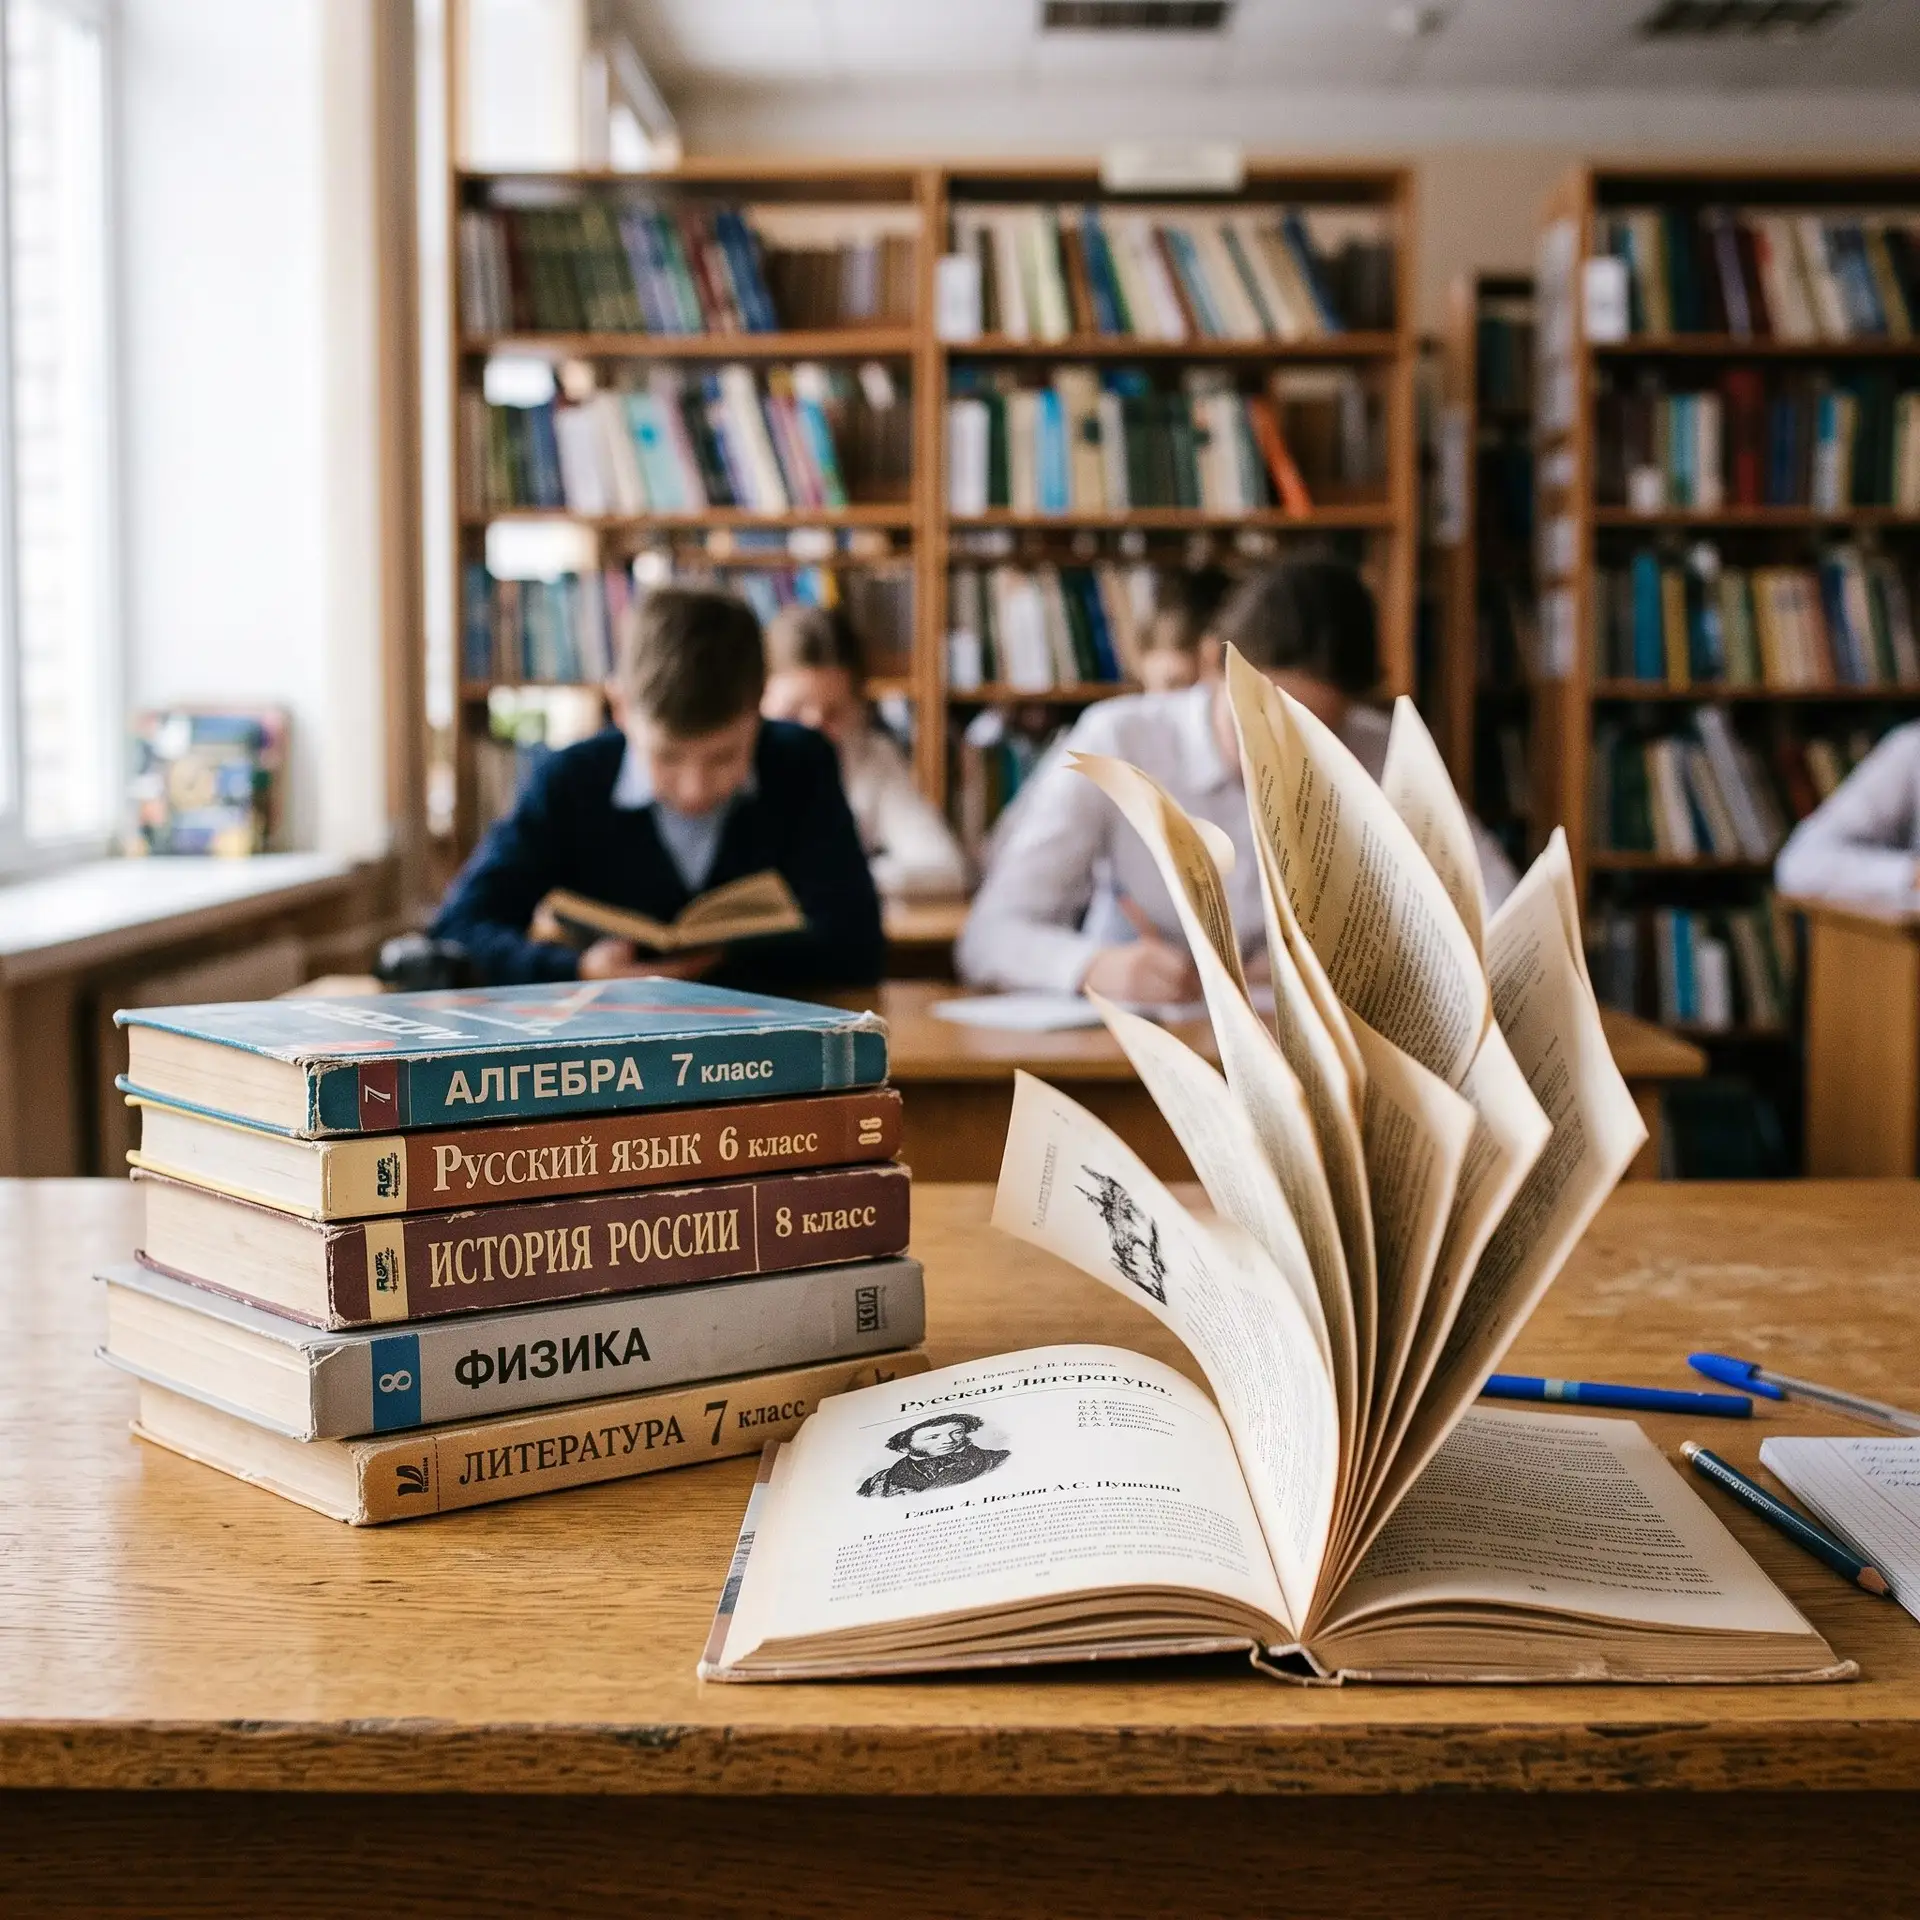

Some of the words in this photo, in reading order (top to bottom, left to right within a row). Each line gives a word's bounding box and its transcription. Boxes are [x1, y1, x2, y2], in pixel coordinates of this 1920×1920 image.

[364, 1084, 391, 1104] 7
[445, 1057, 644, 1106] АЛГЕБРА
[671, 1053, 694, 1087] 7
[701, 1060, 774, 1083] класс
[432, 1135, 599, 1192] Русский
[719, 1126, 738, 1161] 6
[748, 1132, 818, 1158] класс
[428, 1225, 593, 1288] ИСТОРИЯ
[607, 1209, 740, 1266] РОССИИ
[775, 1207, 793, 1238] 8
[802, 1206, 876, 1234] класс
[379, 1370, 412, 1393] 8
[454, 1327, 651, 1389] ФИЗИКА
[900, 1384, 1003, 1412] Русская
[459, 1415, 685, 1485] ЛИТЕРАТУРА
[704, 1400, 728, 1445] 7
[738, 1400, 805, 1429] класс
